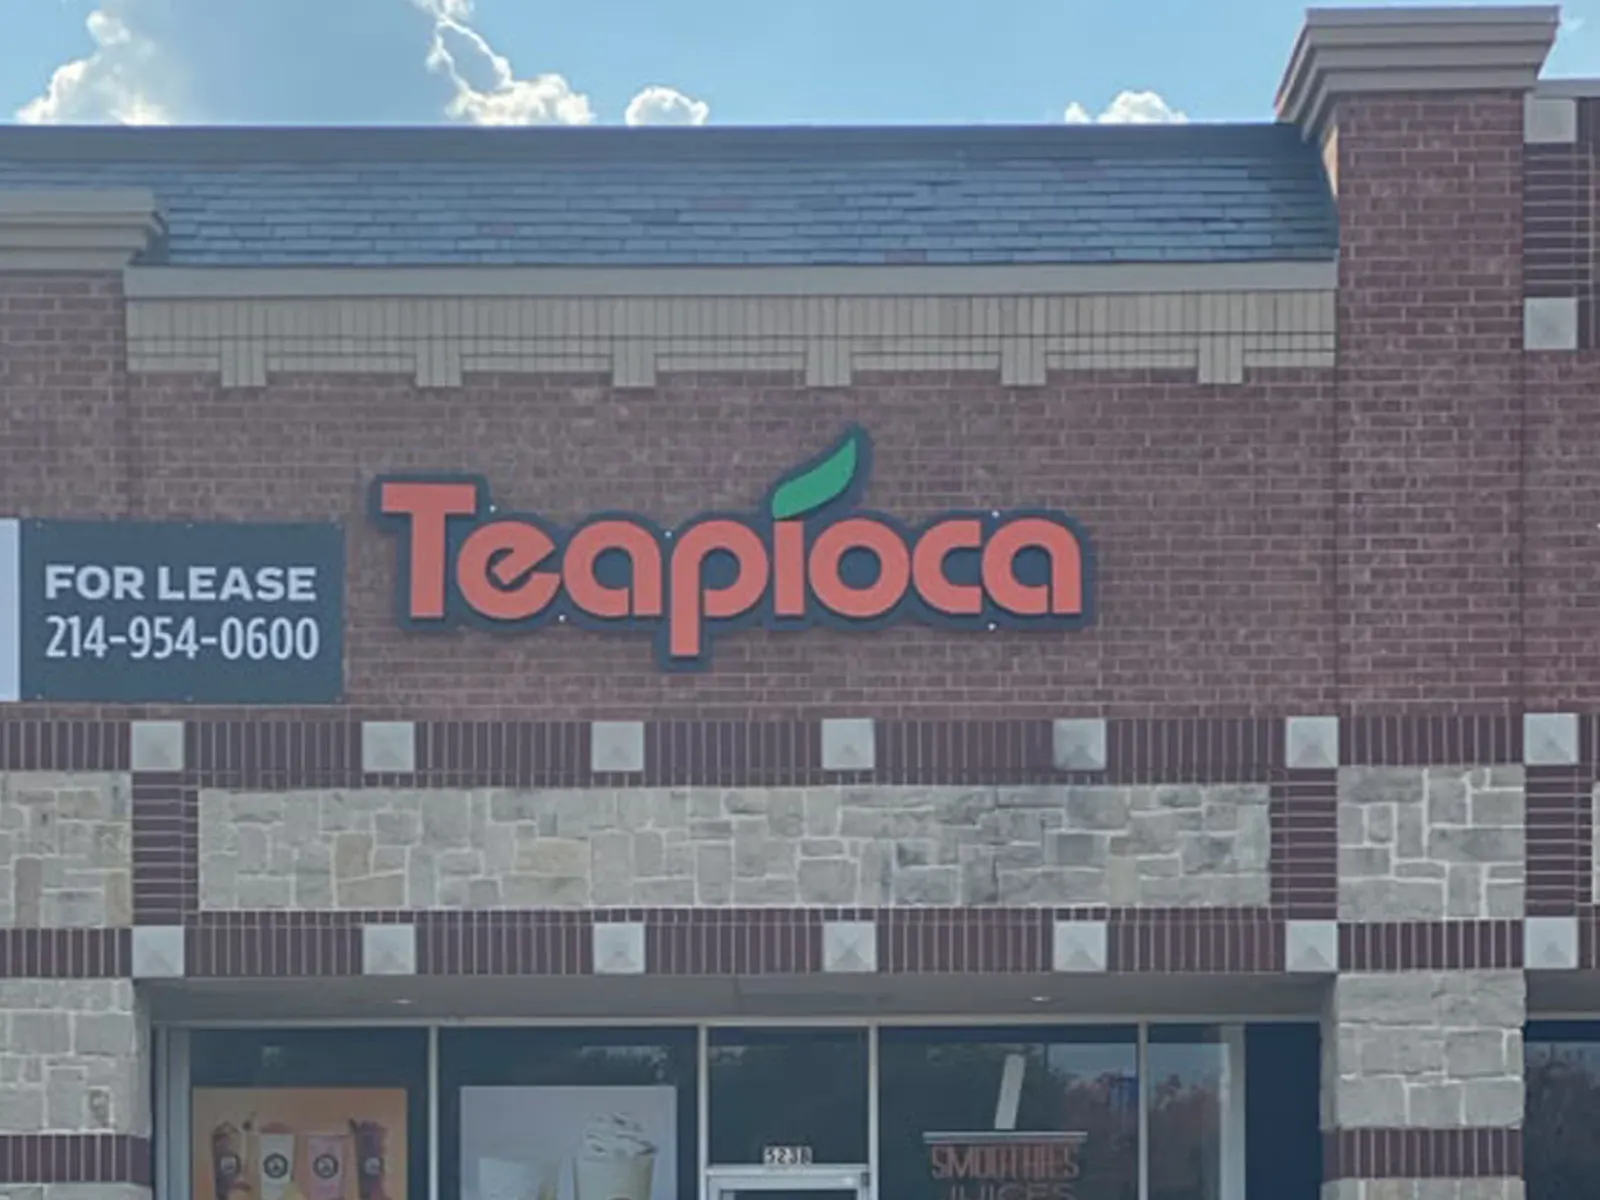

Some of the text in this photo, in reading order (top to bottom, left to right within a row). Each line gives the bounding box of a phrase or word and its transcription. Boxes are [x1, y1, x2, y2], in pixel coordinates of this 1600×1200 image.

[380, 430, 1083, 656] Teapioca
[45, 564, 317, 601] FOR LEASE
[45, 614, 320, 660] 214-954-0600
[931, 1144, 1081, 1180] SMOOTHIES
